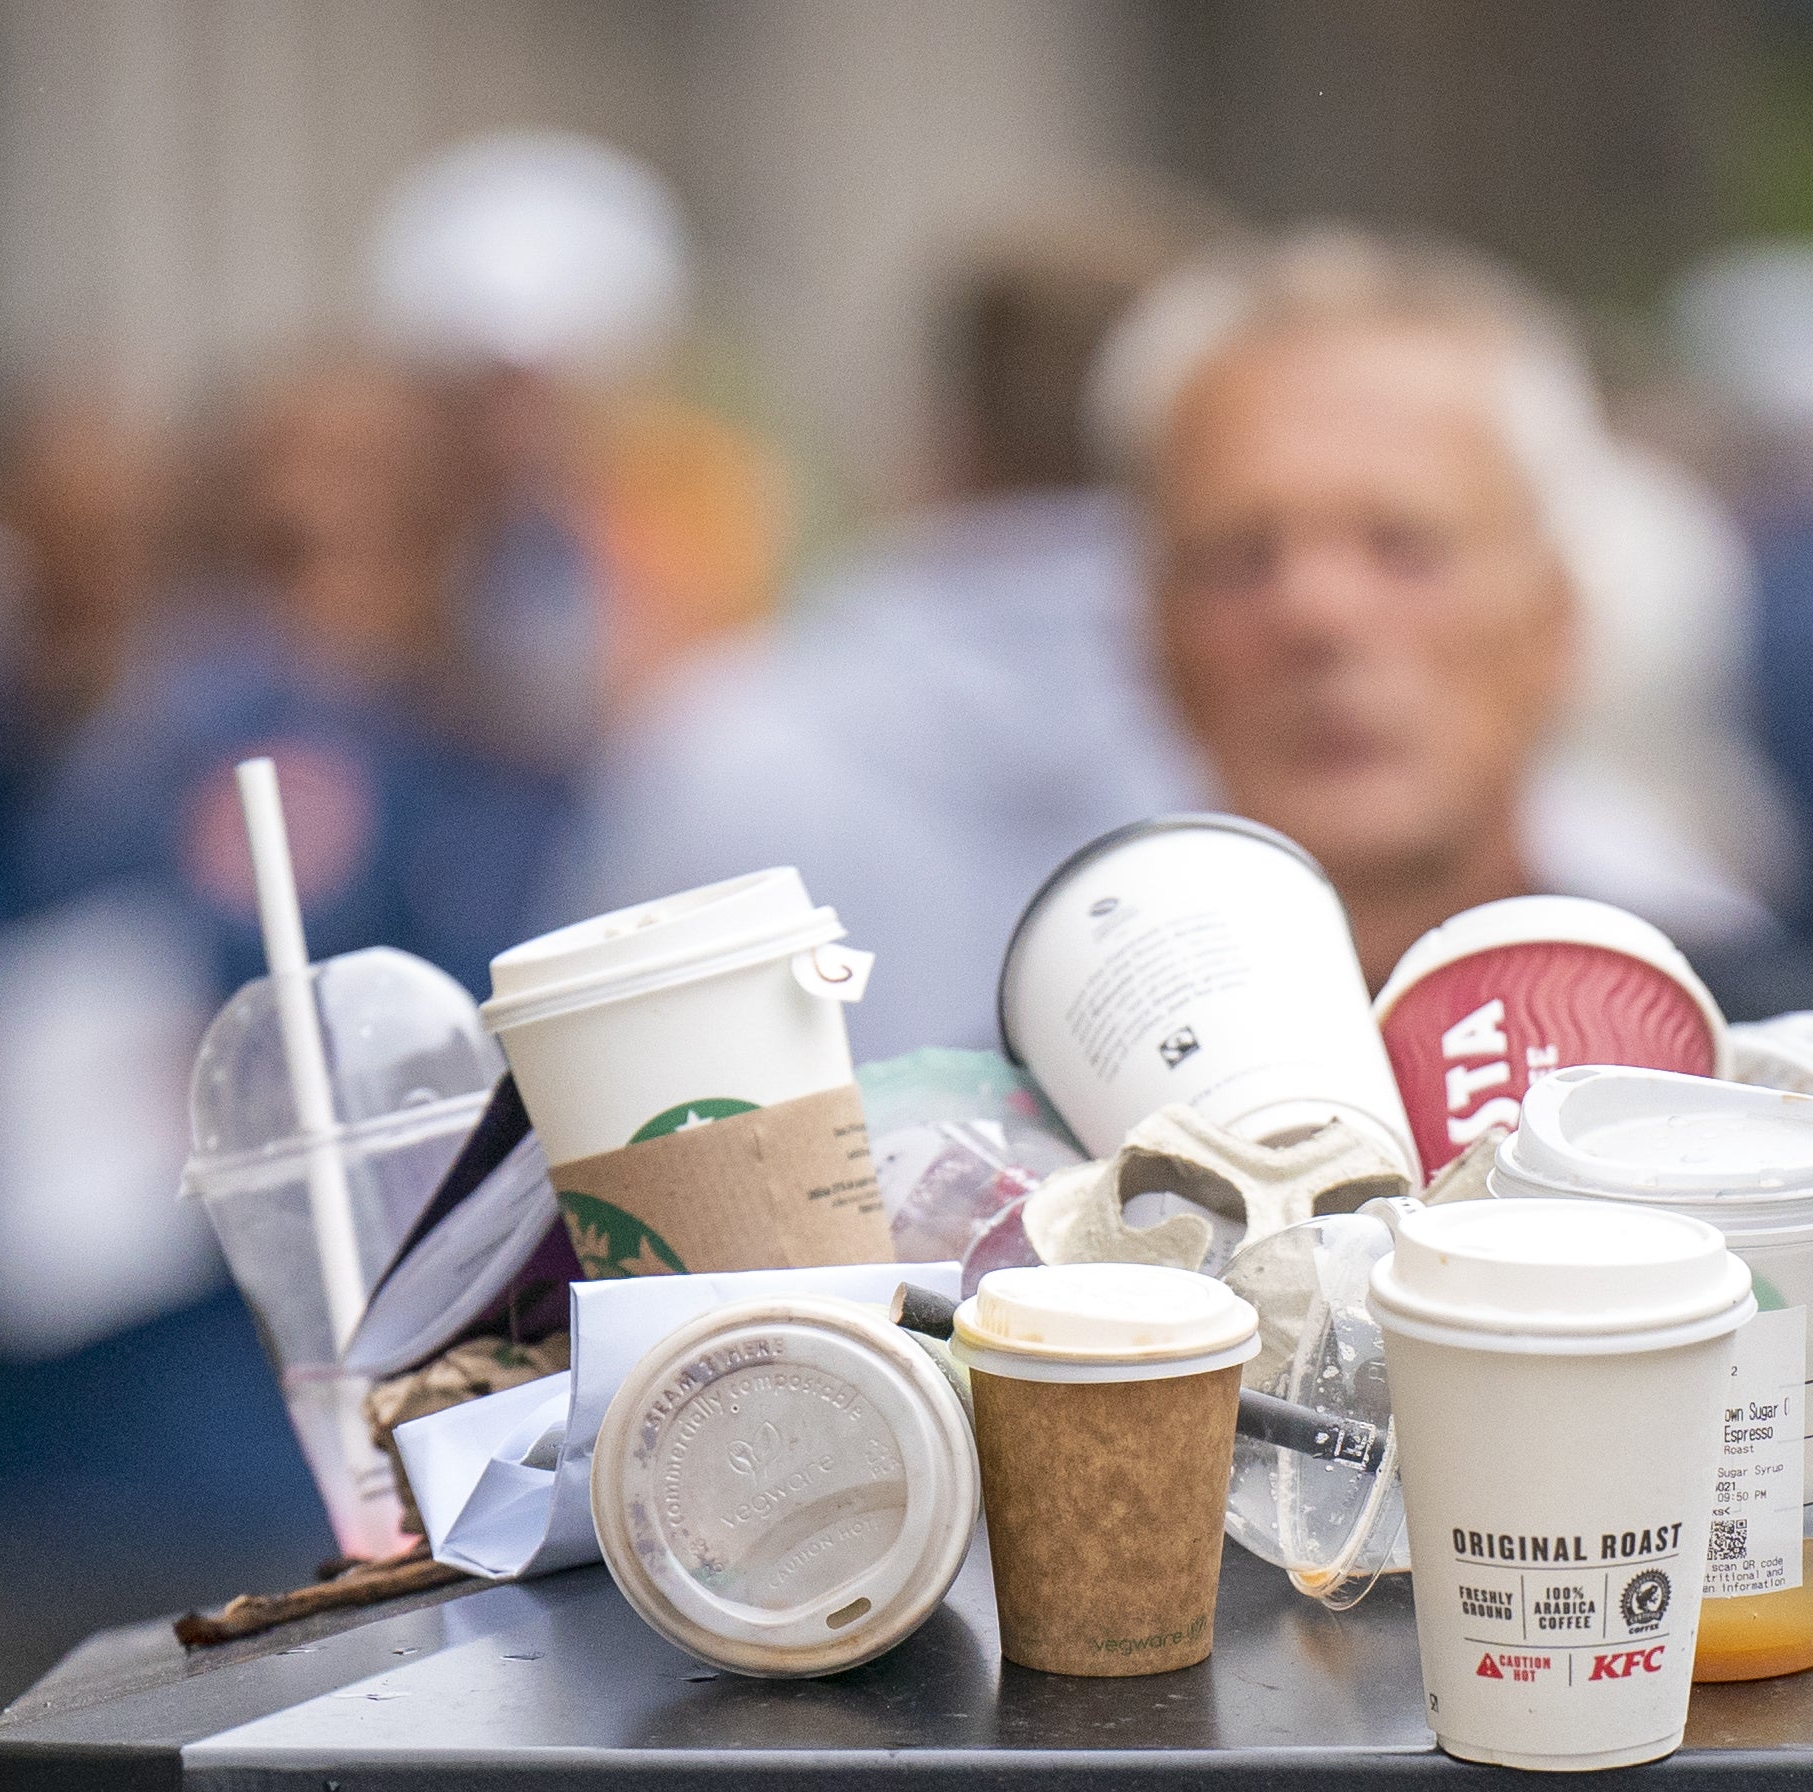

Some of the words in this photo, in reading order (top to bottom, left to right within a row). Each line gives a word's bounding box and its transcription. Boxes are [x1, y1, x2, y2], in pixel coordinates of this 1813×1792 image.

[1730, 1365, 1738, 1376] 2
[1749, 1402, 1779, 1420] Sugar
[1724, 1425, 1773, 1443] Espresso
[665, 1393, 724, 1528] commercially
[731, 1374, 863, 1421] compostable
[1724, 1445, 1754, 1455] Roast
[1717, 1467, 1748, 1478] Sugar
[1754, 1464, 1784, 1475] Syrup
[720, 1453, 837, 1530] vegware
[1717, 1492, 1749, 1502] 09:50
[1754, 1490, 1767, 1500] PM
[1452, 1528, 1588, 1562] ORIGINAL
[1600, 1522, 1683, 1560] ROAST
[769, 1532, 834, 1589] CAUTION
[1711, 1562, 1737, 1572] scan
[1742, 1560, 1755, 1569] QR
[1761, 1556, 1783, 1568] code
[1766, 1567, 1783, 1578] and
[1722, 1578, 1786, 1592] information
[1459, 1585, 1513, 1606] FRESHLY
[1545, 1586, 1585, 1601] 100%
[1462, 1601, 1513, 1621] GROUND
[1534, 1600, 1596, 1615] ARABICA
[1538, 1615, 1592, 1630] COFFEE
[1092, 1631, 1184, 1656] vegware
[1499, 1654, 1551, 1669] CAUTION
[1588, 1646, 1666, 1682] KFC
[1513, 1669, 1536, 1682] HOT
